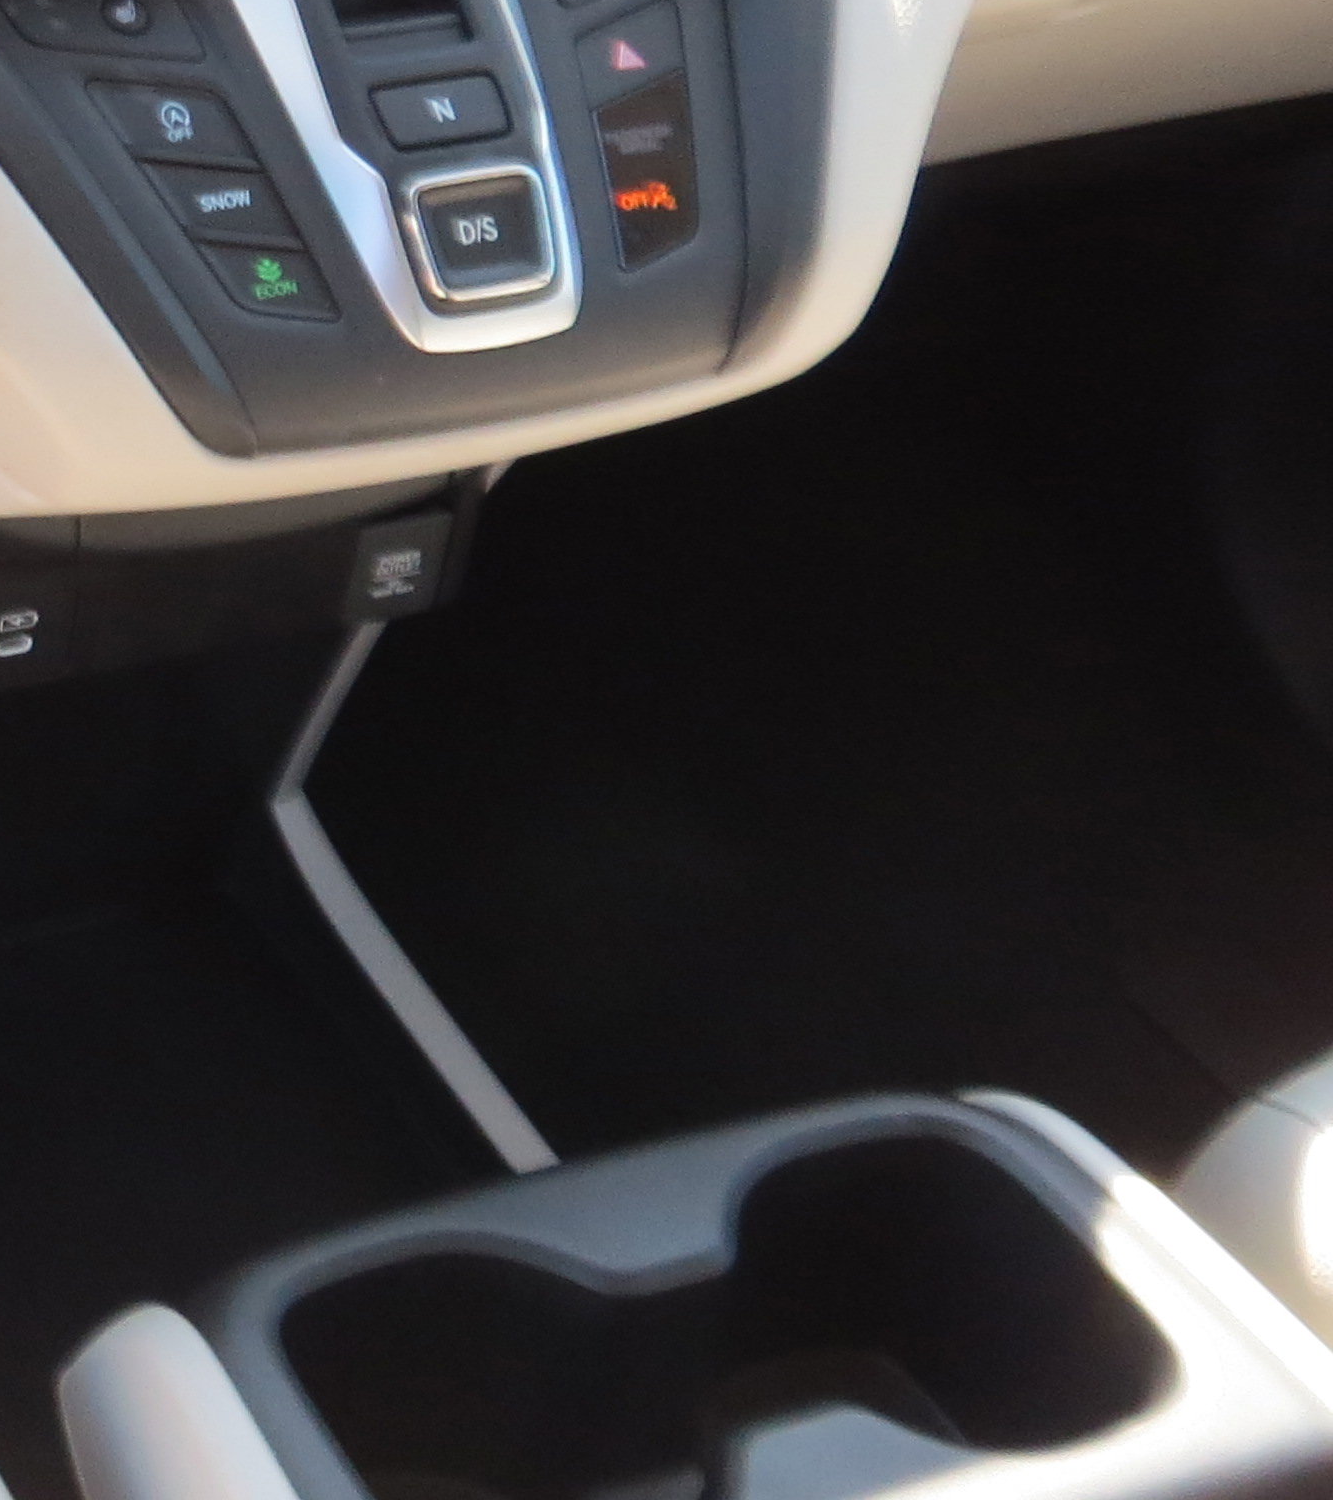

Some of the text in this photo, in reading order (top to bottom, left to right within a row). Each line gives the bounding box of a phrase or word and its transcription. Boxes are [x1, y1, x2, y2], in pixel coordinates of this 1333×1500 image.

[427, 97, 457, 124] N
[167, 126, 195, 143] OFF
[198, 190, 252, 213] SNOW
[457, 217, 500, 246] D/S
[254, 280, 300, 302] ECON
